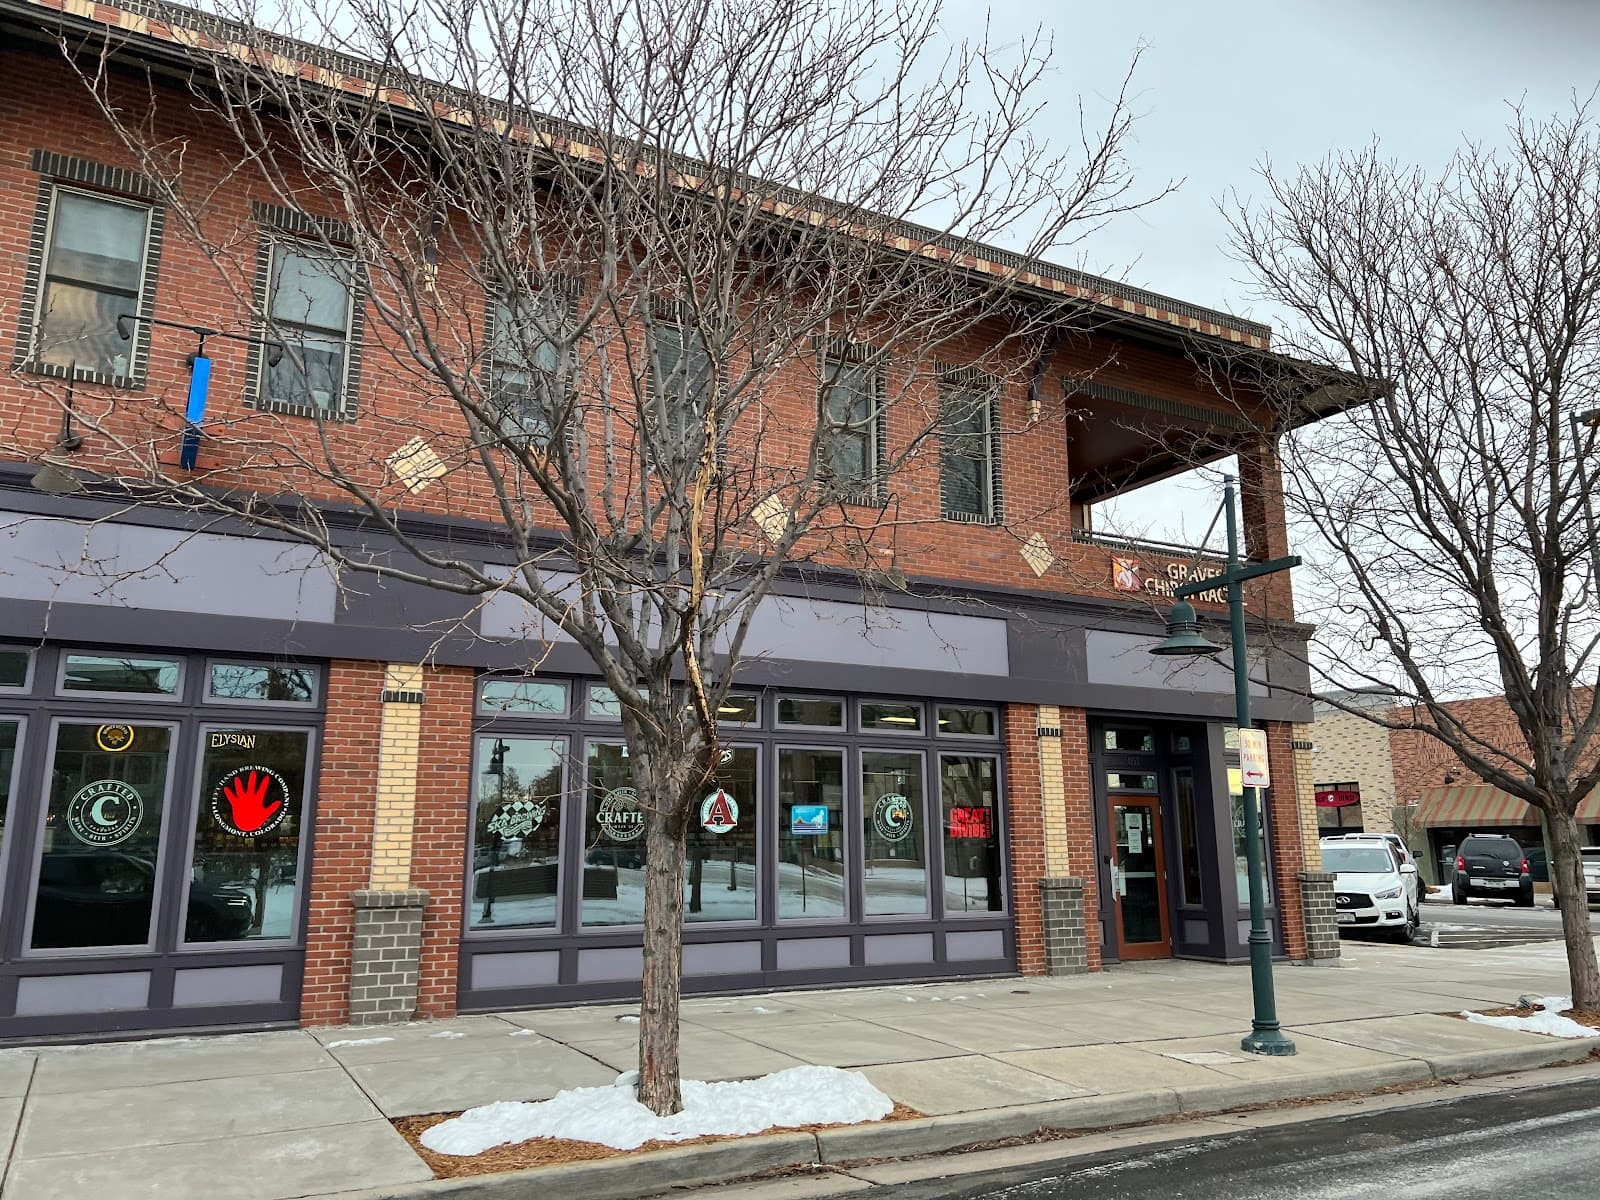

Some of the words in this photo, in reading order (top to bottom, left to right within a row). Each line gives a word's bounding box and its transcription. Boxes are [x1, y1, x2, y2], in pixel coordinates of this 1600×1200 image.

[1145, 577, 1248, 606] CHIRRAC
[211, 733, 256, 749] ELYSIAN
[80, 783, 134, 801] CRAFTED
[219, 769, 239, 786] HAND
[239, 765, 275, 776] BREWING
[274, 774, 290, 808] COMPANY
[91, 795, 120, 826] C
[596, 811, 644, 823] CRAFTE
[703, 789, 737, 826] A
[950, 807, 984, 823] GREAT
[88, 832, 106, 841] BEER
[113, 816, 137, 838] SPIRITS
[249, 811, 286, 837] COLORADO
[487, 818, 508, 833] SKA
[950, 823, 986, 839] DIVIDE
